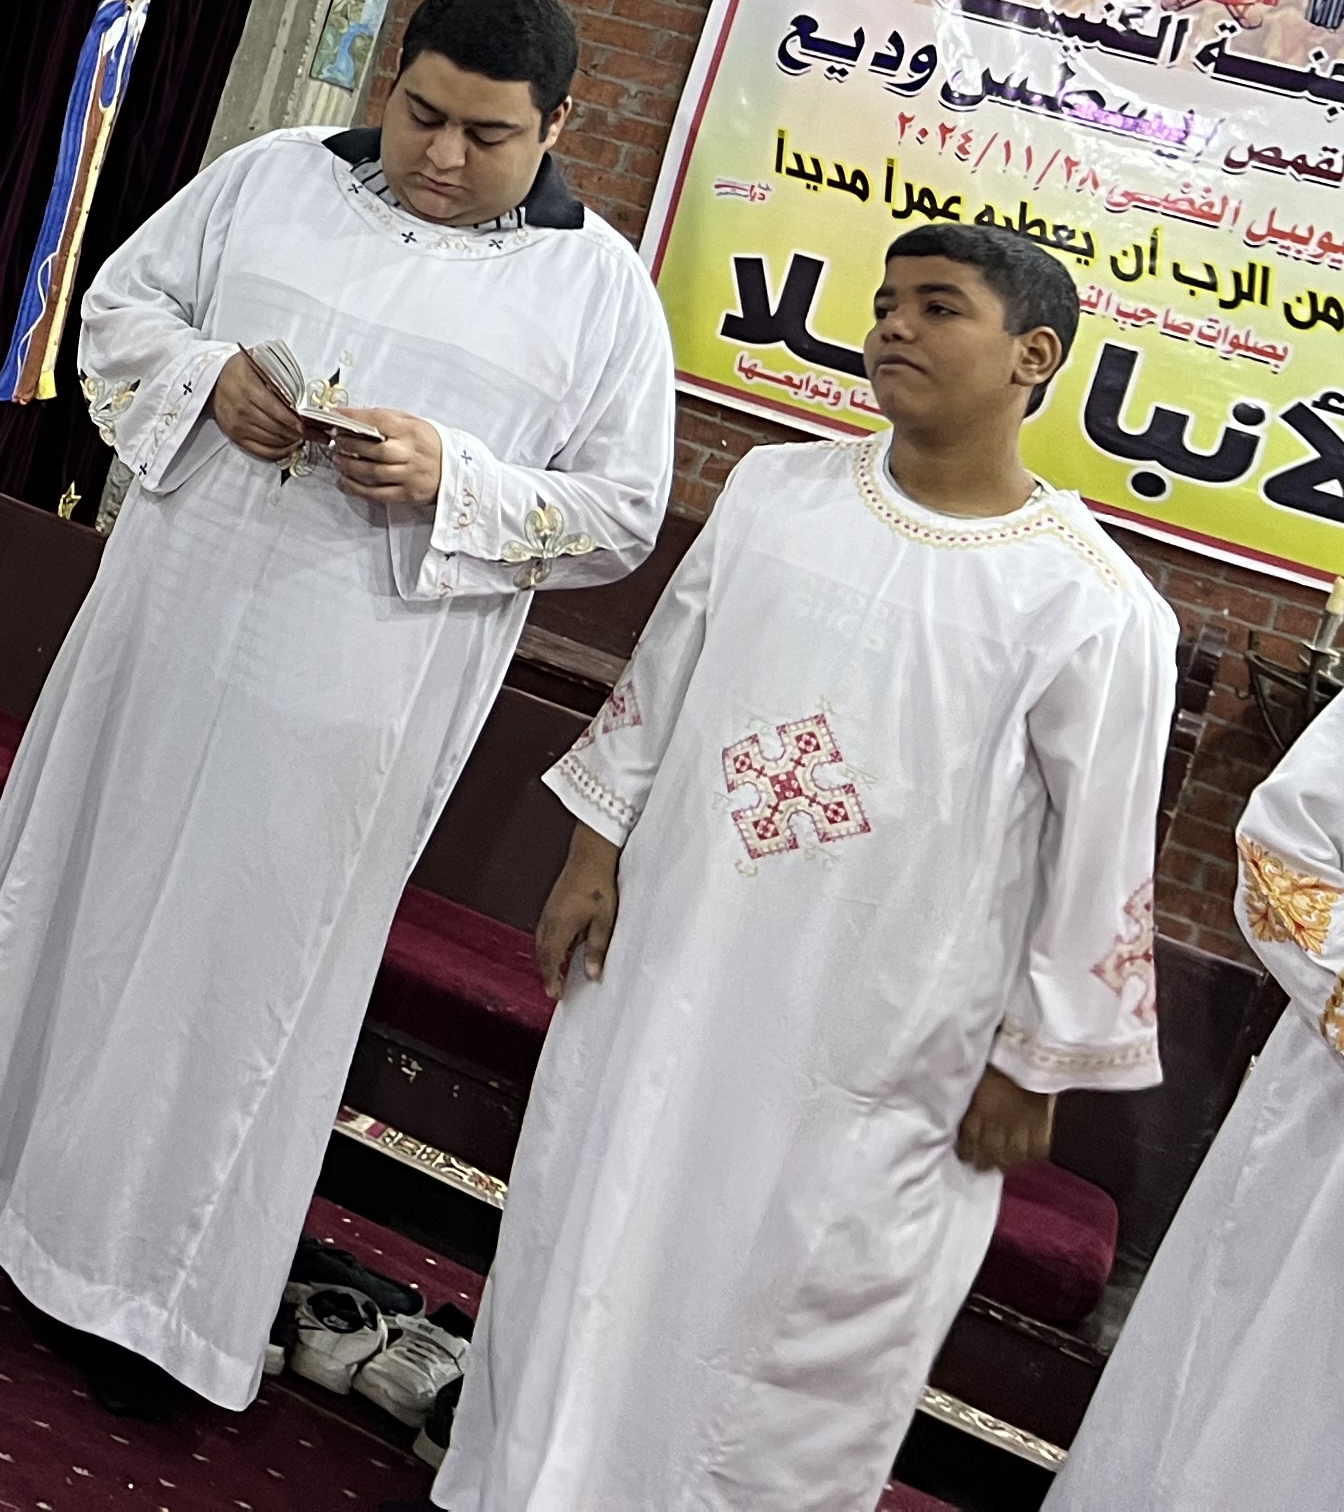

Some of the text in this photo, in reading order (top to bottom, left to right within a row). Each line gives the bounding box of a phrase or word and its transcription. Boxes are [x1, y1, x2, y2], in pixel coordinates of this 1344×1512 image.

[777, 13, 939, 98] وديع
[1109, 226, 1161, 283] أن
[1171, 262, 1271, 310] الرب
[1281, 289, 1344, 332] من
[1196, 317, 1290, 372] بصلوات
[737, 355, 842, 406] وتوابعها
